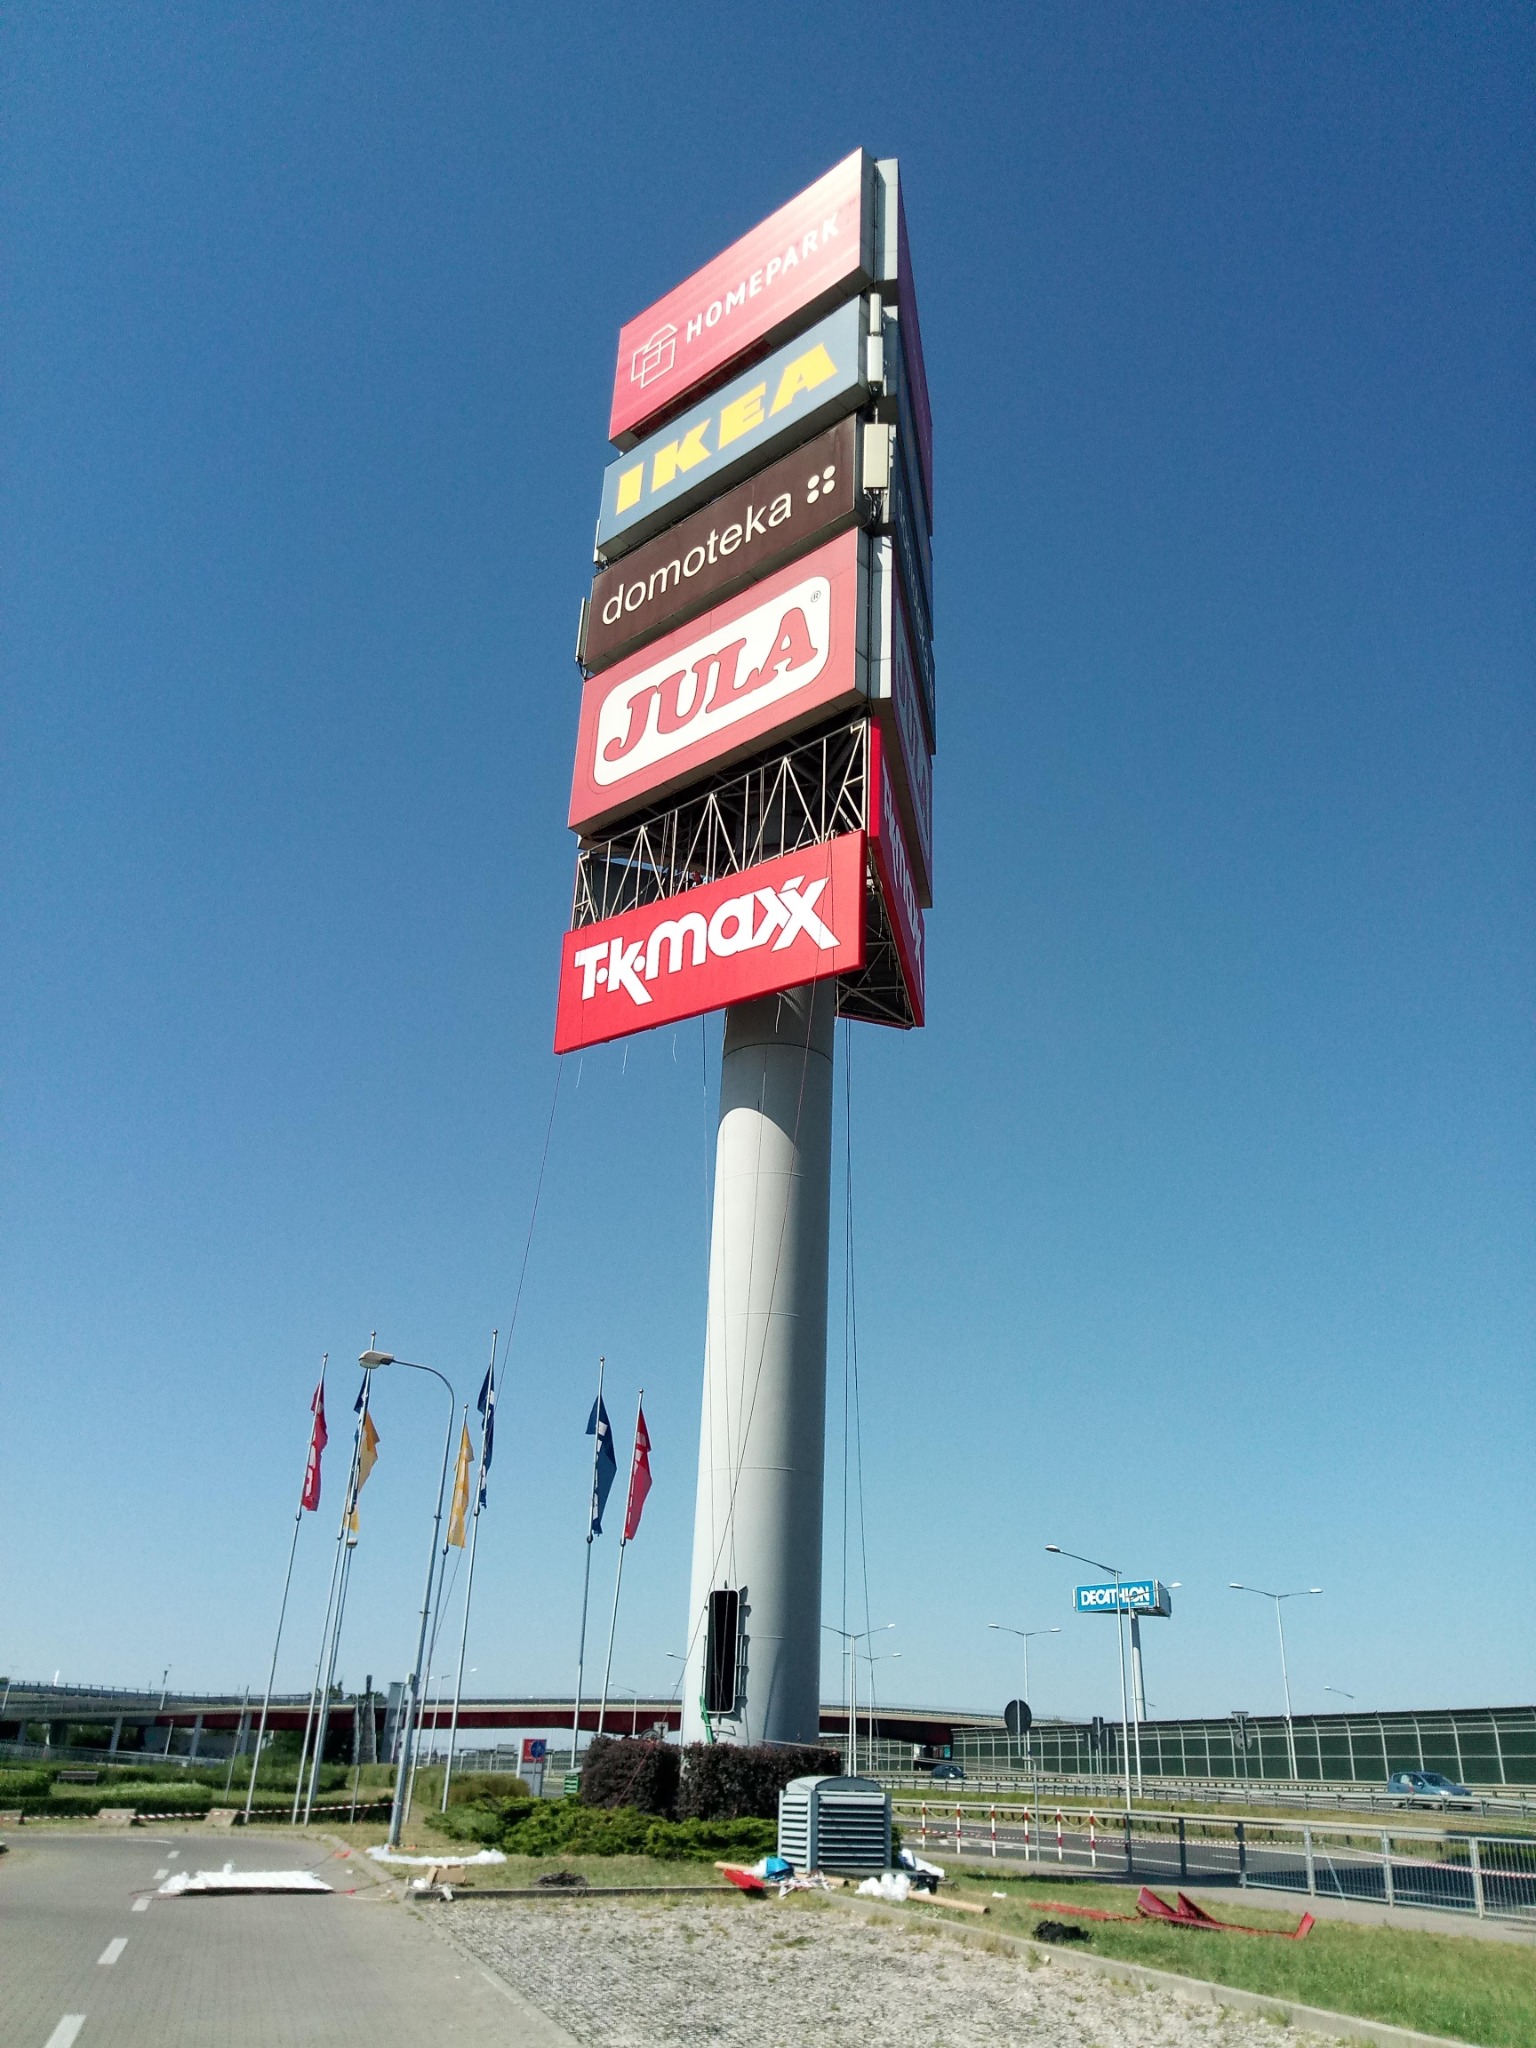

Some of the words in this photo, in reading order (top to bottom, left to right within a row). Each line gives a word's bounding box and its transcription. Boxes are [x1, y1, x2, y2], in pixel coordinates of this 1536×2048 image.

[687, 213, 839, 343] HOMEPARK
[616, 343, 838, 515] IKEA
[602, 492, 792, 624] domoteka
[604, 606, 818, 761] JULA
